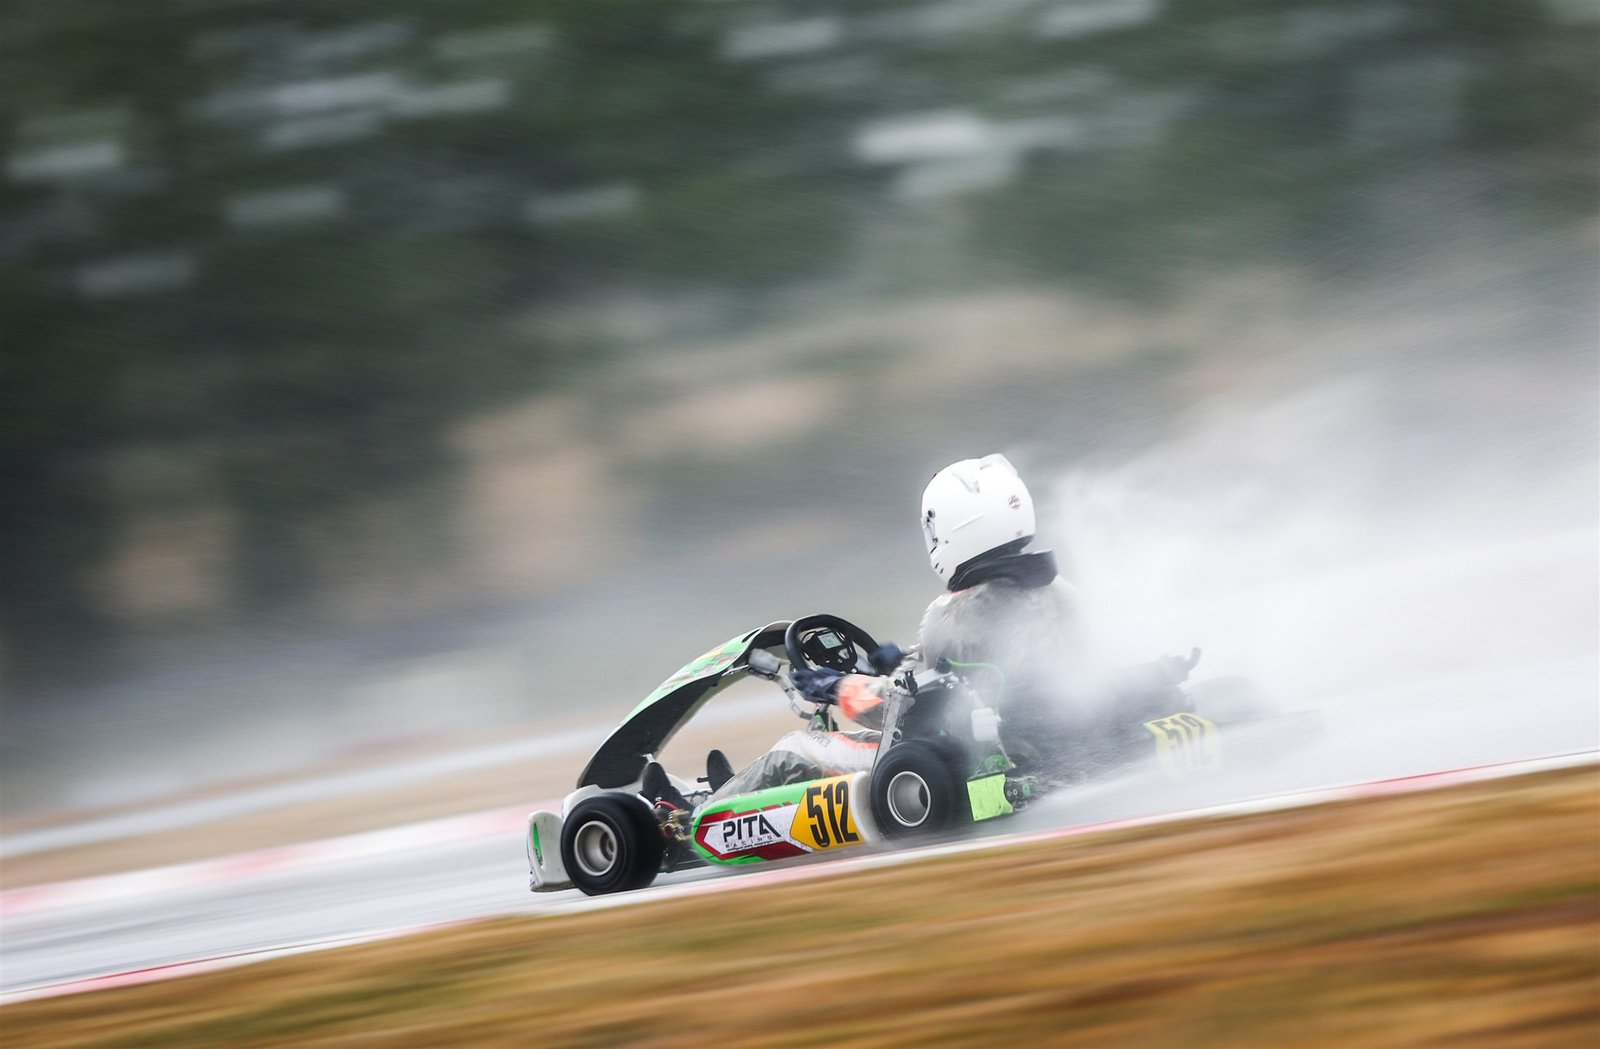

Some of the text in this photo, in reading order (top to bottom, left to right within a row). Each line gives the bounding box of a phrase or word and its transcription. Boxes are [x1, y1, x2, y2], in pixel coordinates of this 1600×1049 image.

[723, 814, 781, 843] PITA
[806, 781, 859, 848] 512
[725, 834, 773, 849] RACING
